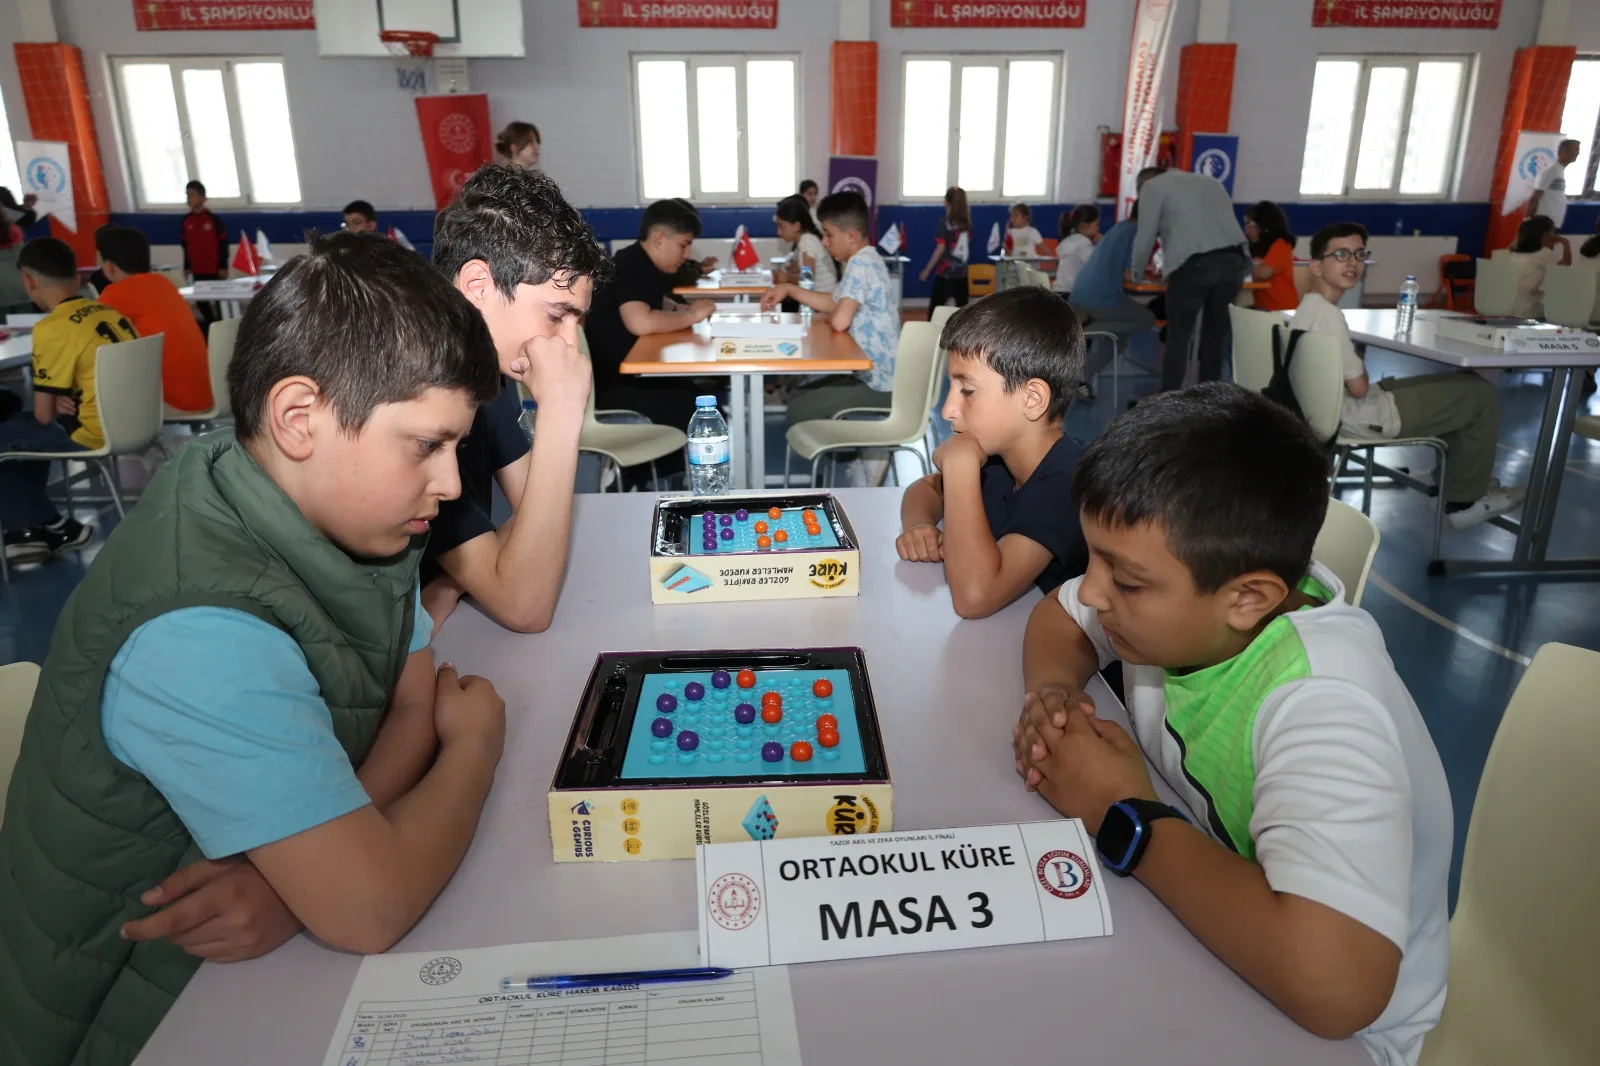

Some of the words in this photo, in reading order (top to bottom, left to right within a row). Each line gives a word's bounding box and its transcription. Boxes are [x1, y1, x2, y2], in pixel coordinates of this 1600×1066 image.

[200, 5, 315, 24] ŞAMPİYONLU
[622, 3, 637, 18] İL
[640, 3, 773, 22] ŞAMPİYONLUĞU
[934, 3, 948, 18] İL
[951, 3, 1080, 22] ŞAMPİYONLUĞU
[1372, 4, 1495, 22] ŞAMPİYONLUĞU
[808, 561, 848, 581] KÜRE
[833, 795, 865, 834] KÜR
[573, 827, 583, 857] GENIUS
[583, 820, 594, 857] CURIOUS
[779, 852, 935, 882] ORTAOKUL
[942, 843, 1016, 871] KÜRE
[1051, 861, 1078, 888] B
[819, 894, 957, 941] MASA
[970, 891, 994, 929] 3
[478, 992, 533, 1004] ORTAOKUL
[566, 987, 600, 996] HAKEM
